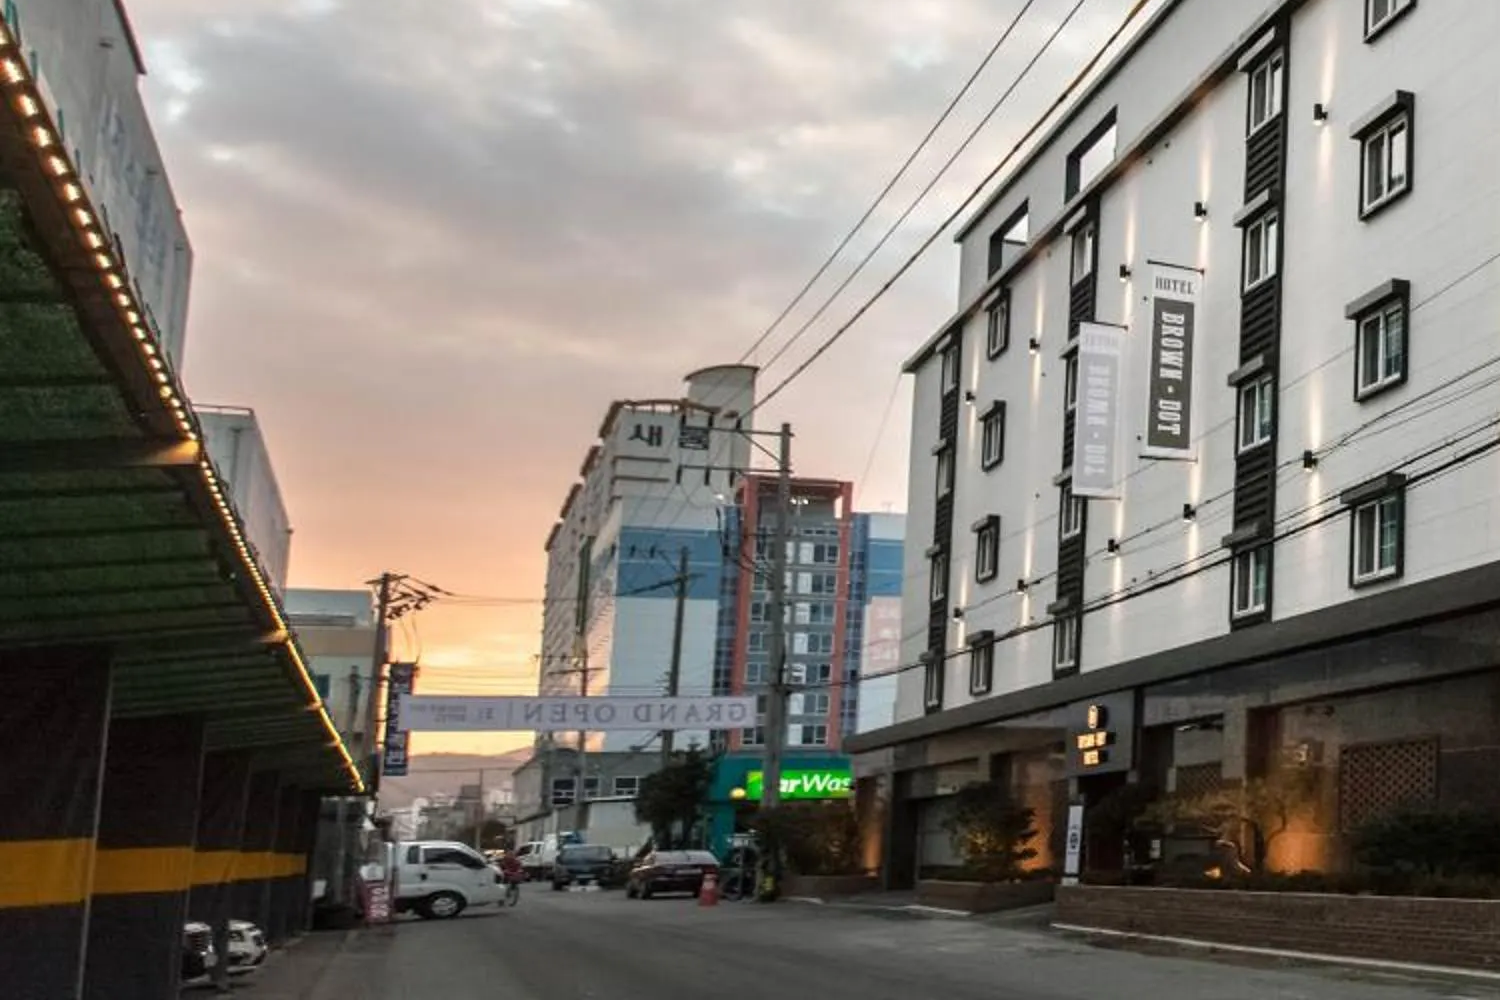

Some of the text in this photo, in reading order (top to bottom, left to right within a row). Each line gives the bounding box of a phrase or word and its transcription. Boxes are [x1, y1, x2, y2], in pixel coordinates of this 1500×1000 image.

[1155, 276, 1194, 295] HOTEL
[1159, 311, 1185, 381] BROWN
[1157, 399, 1181, 436] DOT
